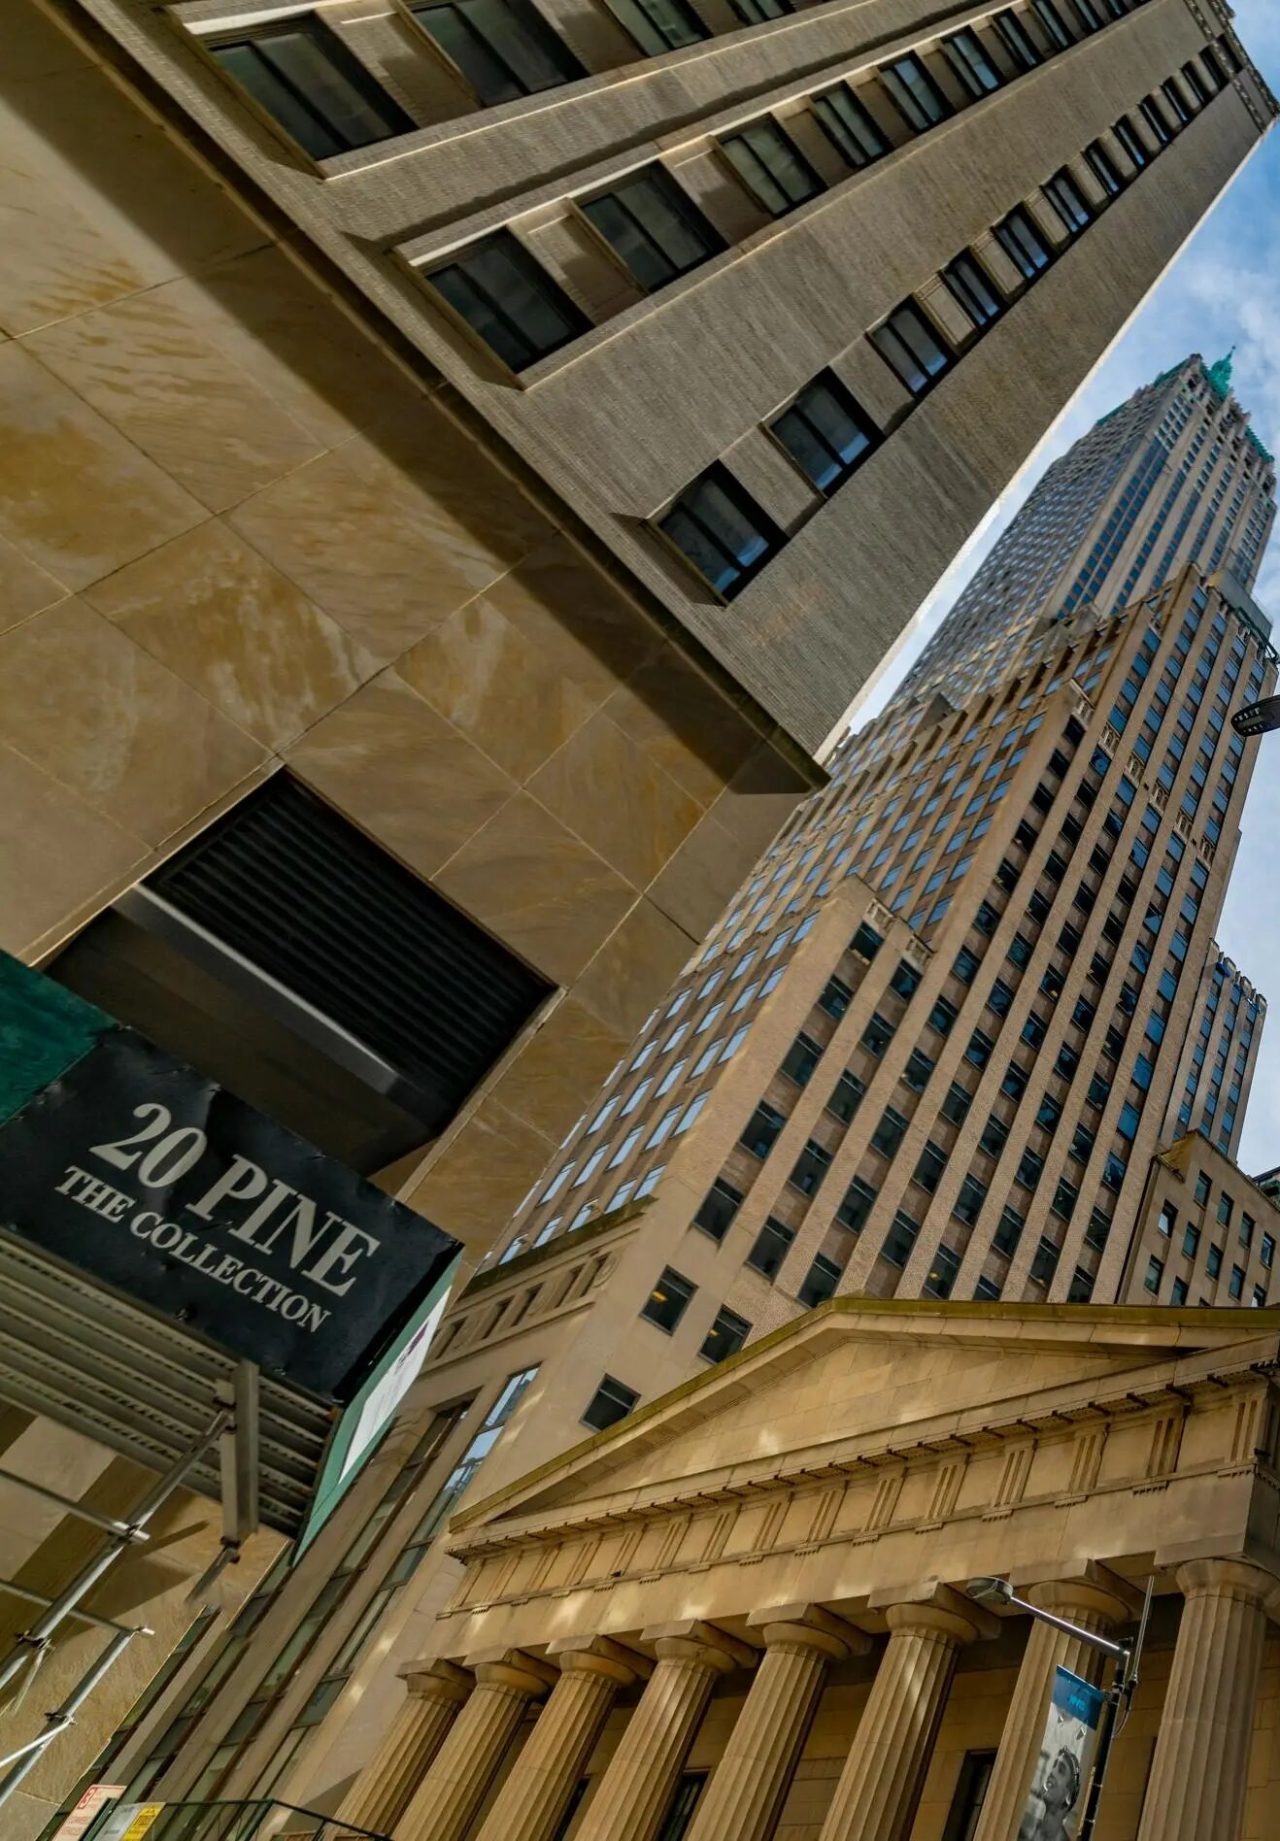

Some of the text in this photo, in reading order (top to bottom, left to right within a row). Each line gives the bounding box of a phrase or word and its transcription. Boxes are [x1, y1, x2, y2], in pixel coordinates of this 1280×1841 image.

[54, 1166, 332, 1333] THE COLLECTION
[89, 1103, 380, 1297] 20 PINE
